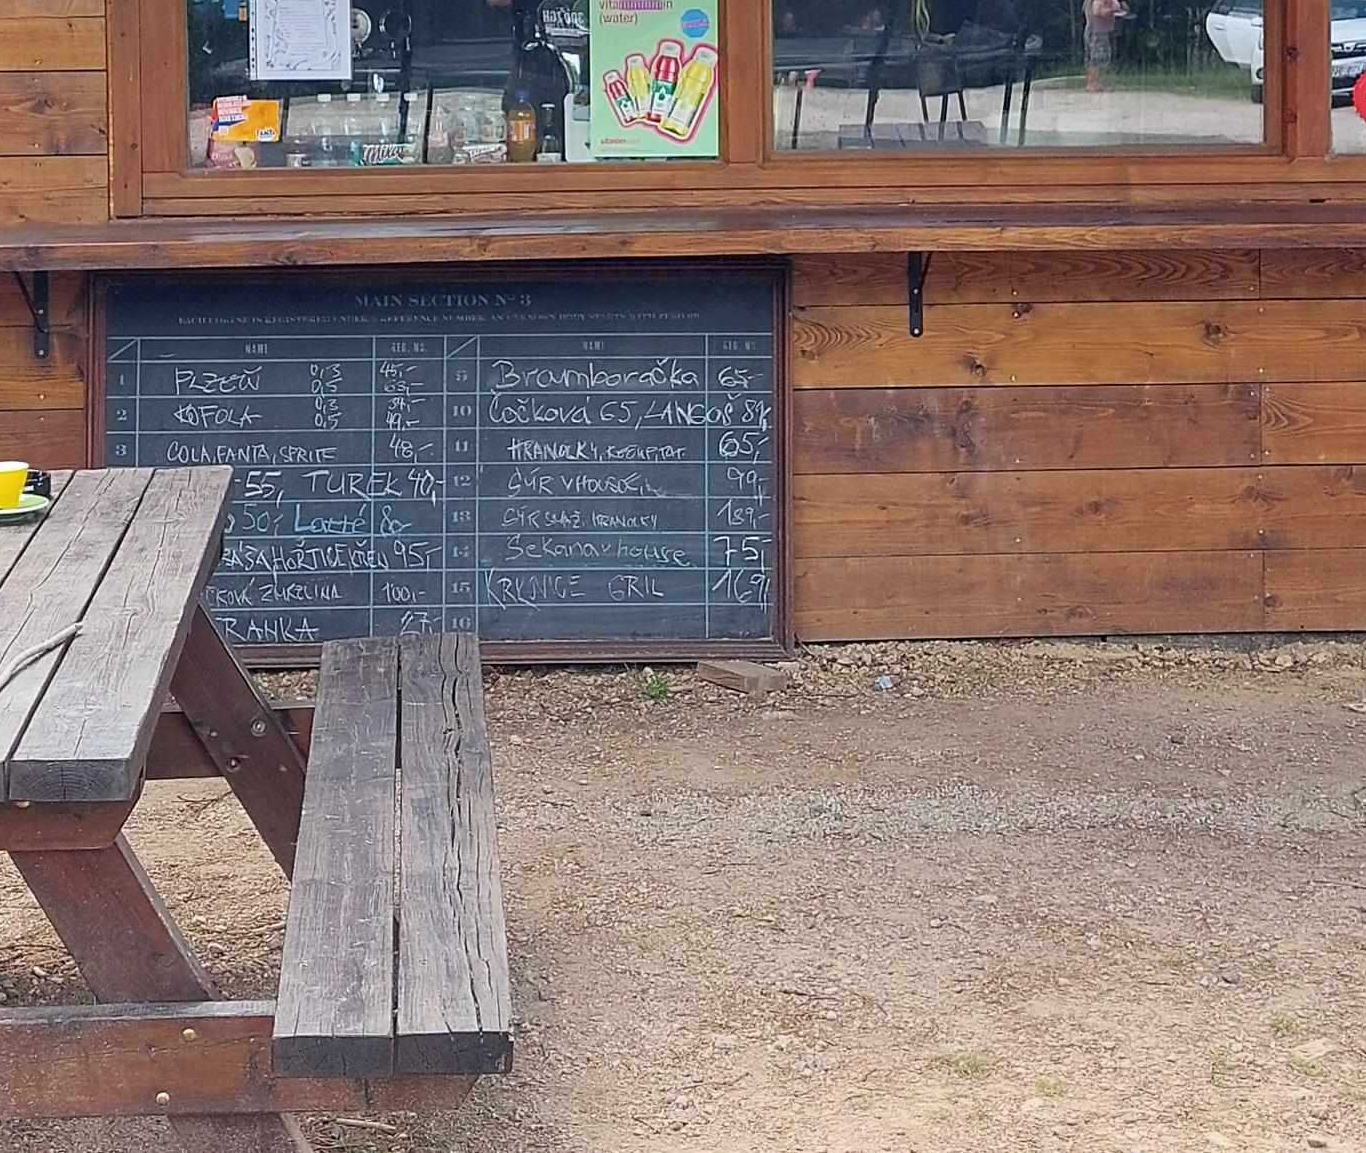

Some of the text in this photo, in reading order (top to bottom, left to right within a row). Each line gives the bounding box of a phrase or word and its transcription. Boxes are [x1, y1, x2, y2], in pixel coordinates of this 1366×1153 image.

[599, 12, 638, 25] (water)
[355, 295, 402, 306] MAIN
[408, 294, 488, 306] SECTION
[174, 404, 263, 428] KOFOLA
[452, 405, 472, 418] 10
[302, 470, 403, 501] TUREK
[451, 475, 471, 487] 12
[608, 574, 666, 601] GRIL
